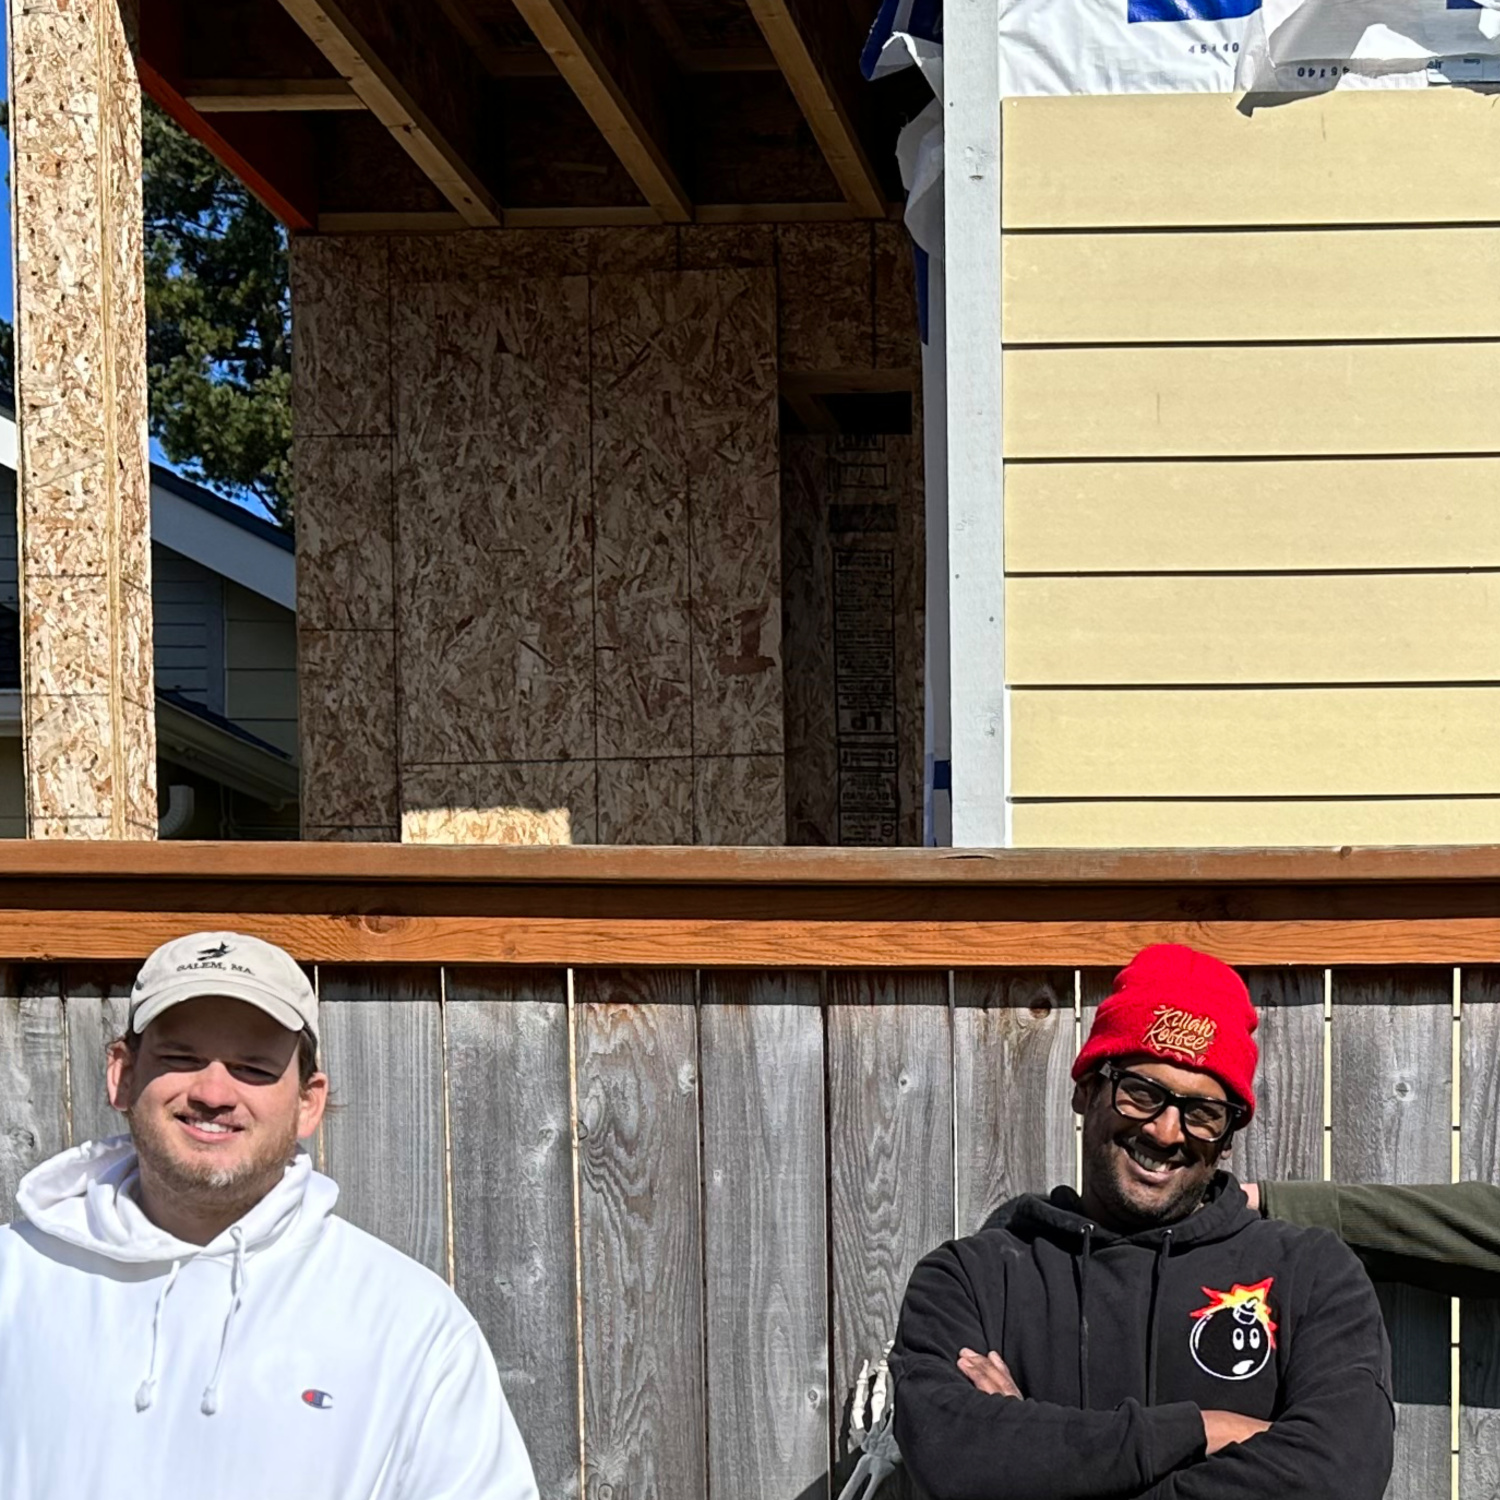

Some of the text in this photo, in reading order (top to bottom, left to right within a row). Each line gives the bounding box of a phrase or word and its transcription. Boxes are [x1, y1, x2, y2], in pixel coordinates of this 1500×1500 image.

[850, 711, 882, 731] LP
[176, 961, 227, 973] SALEM,
[1142, 1025, 1209, 1055] Koffee
